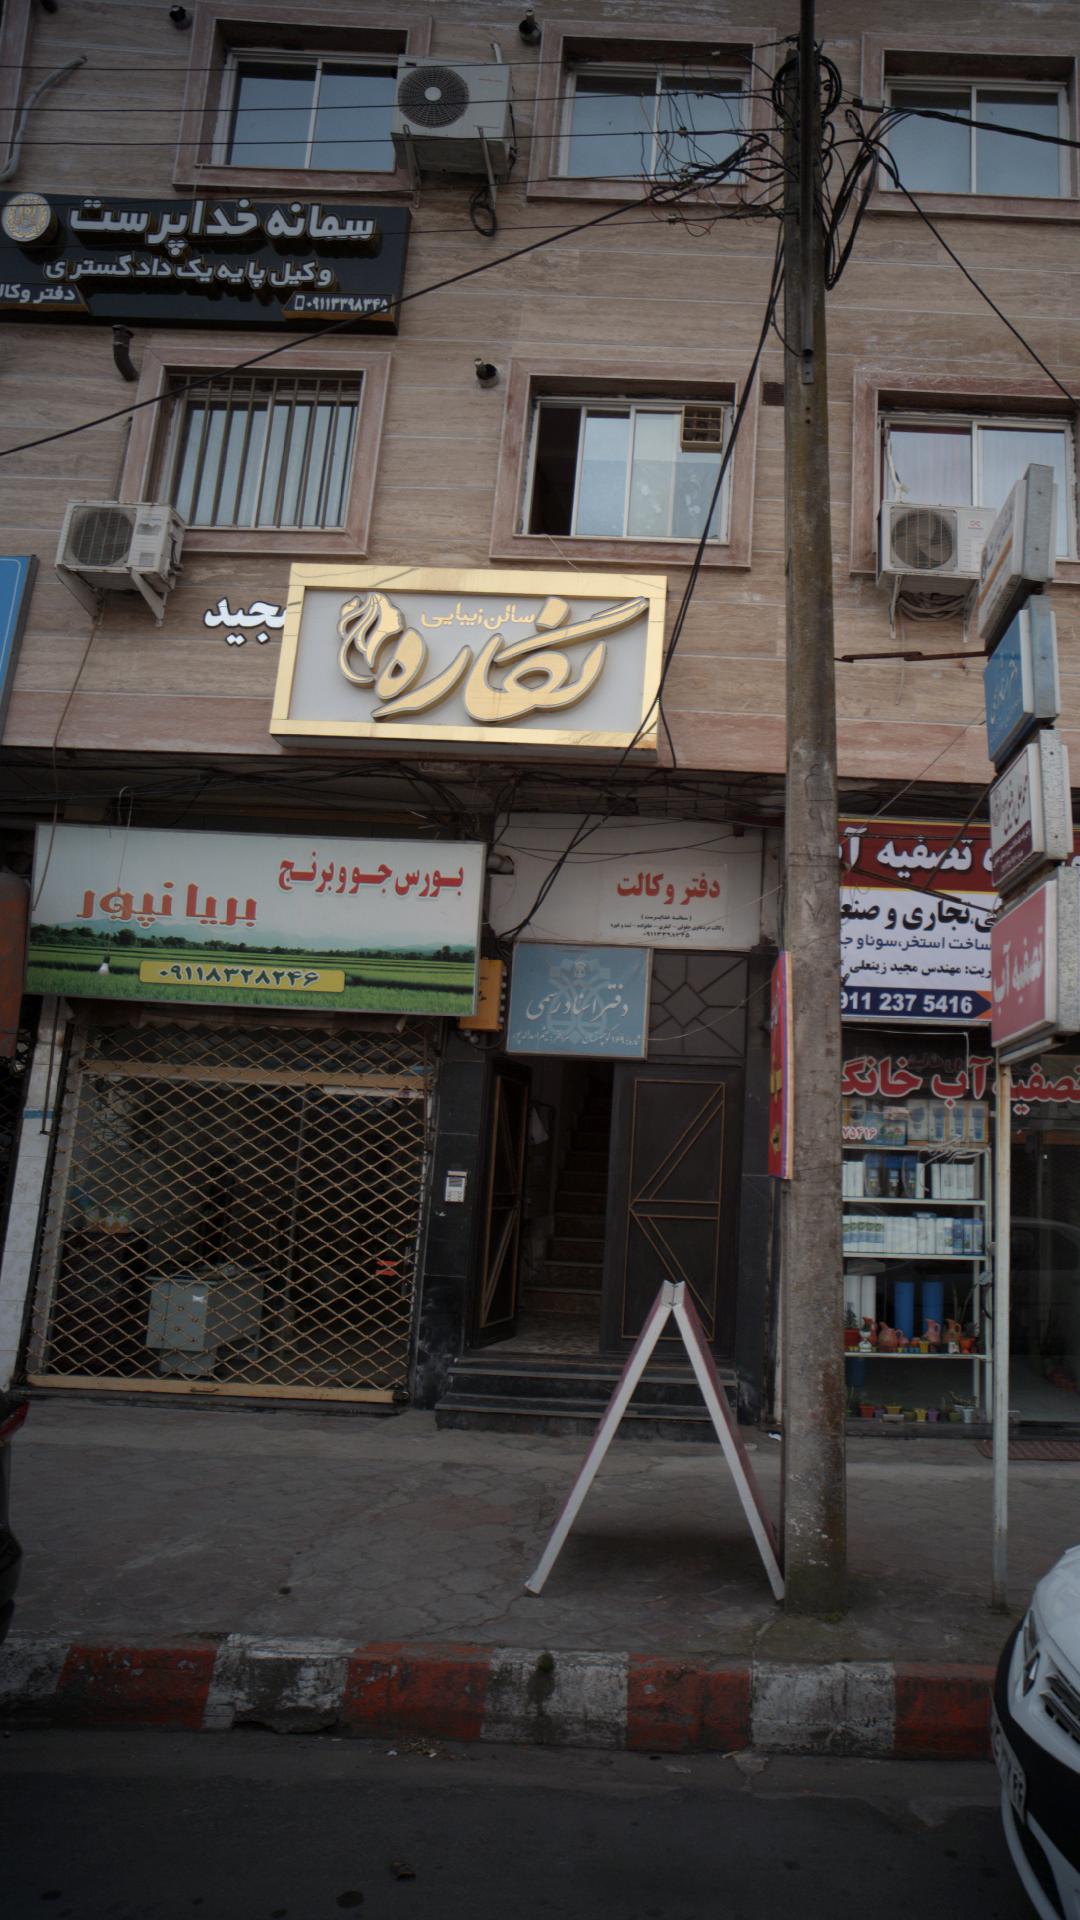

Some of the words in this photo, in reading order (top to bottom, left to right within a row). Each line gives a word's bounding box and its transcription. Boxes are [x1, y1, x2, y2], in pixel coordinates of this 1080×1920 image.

[69, 197, 260, 257] خداپرست
[265, 201, 377, 241] سمانه
[45, 254, 172, 281] دادگستری
[177, 258, 212, 282] یک
[218, 259, 266, 288] پایه
[270, 260, 332, 287] وکیل
[0, 283, 31, 304] وکال
[33, 285, 76, 304] دفتر
[420, 600, 483, 628] زیبایی
[484, 602, 536, 630] سالن
[876, 836, 973, 878] تصفیه
[278, 852, 334, 893] برنج
[395, 866, 464, 897] بورس
[617, 873, 675, 905] وکالت
[680, 872, 721, 905] دفتر
[841, 900, 880, 921] صنع
[890, 962, 918, 975] مجید
[921, 963, 962, 977] مهندس
[879, 992, 917, 1012] 237
[923, 995, 973, 1014] 5416
[841, 1055, 923, 1098] خانگ
[931, 1055, 994, 1110] آب
